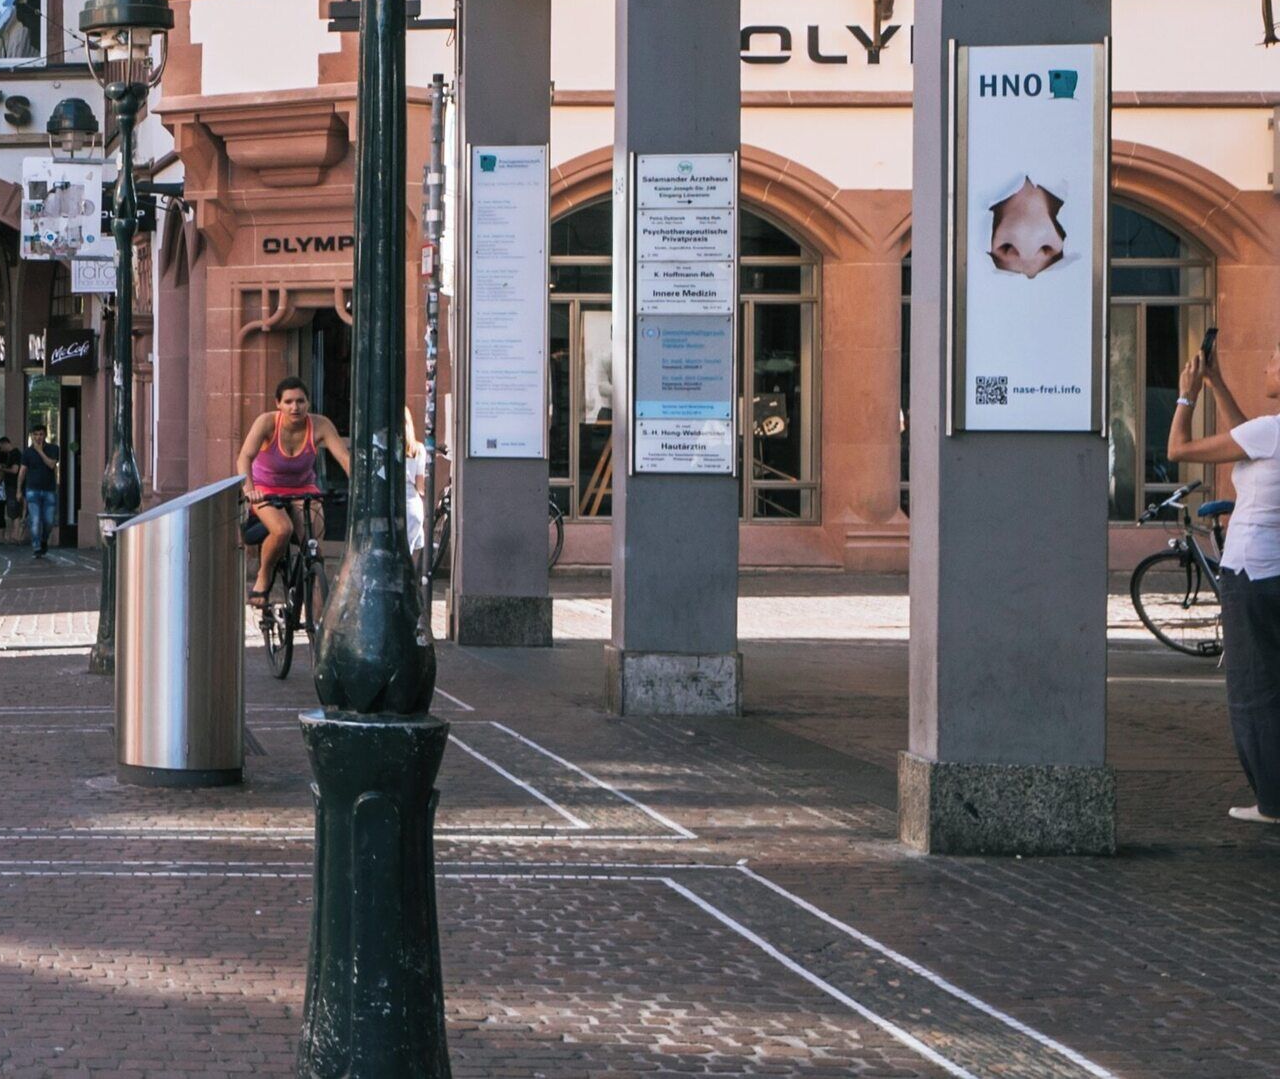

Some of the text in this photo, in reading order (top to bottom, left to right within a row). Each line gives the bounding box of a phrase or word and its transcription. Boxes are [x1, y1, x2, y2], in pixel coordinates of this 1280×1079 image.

[740, 25, 914, 64] OLY
[980, 73, 1042, 97] HNO
[690, 174, 728, 182] Ärztehaus
[643, 228, 728, 236] Psychotherapeutische
[263, 236, 355, 253] OLYMP
[1013, 385, 1081, 394] nase-frei.info
[661, 442, 706, 450] Hautärztin
